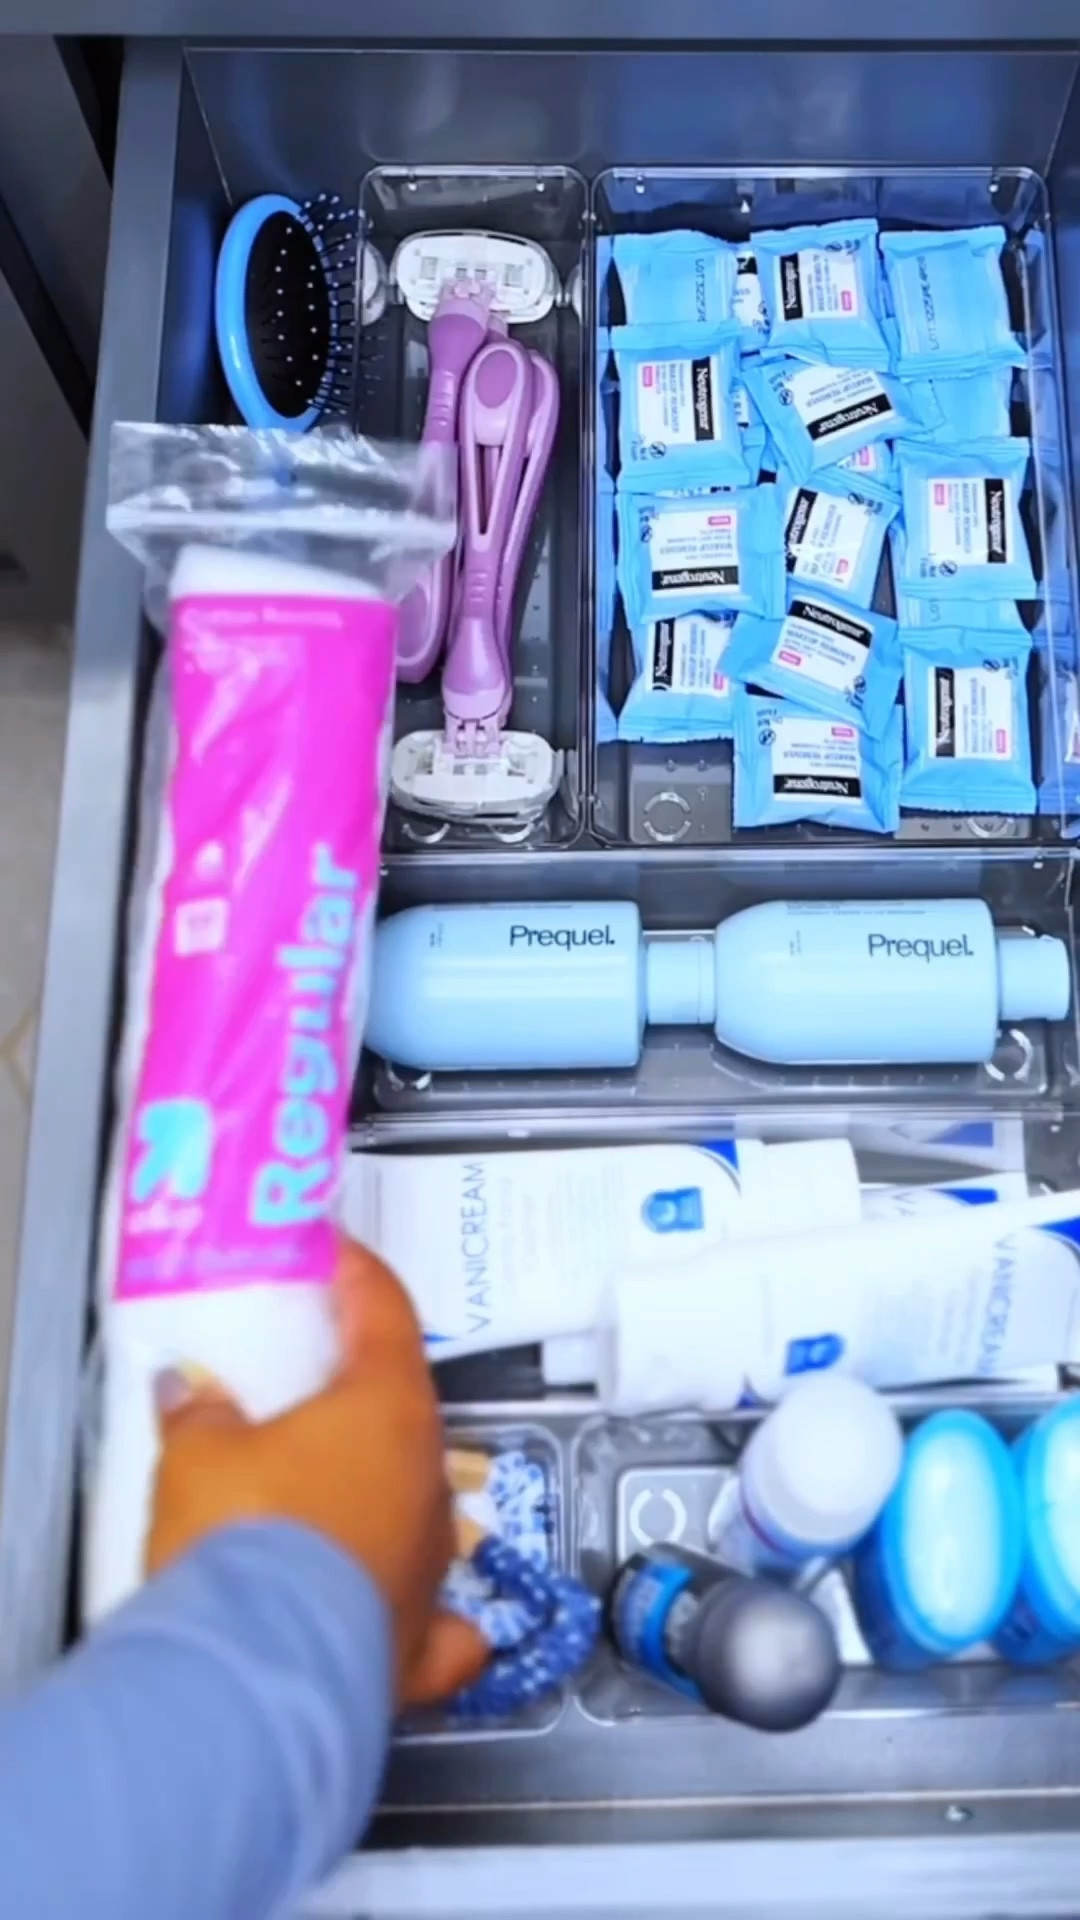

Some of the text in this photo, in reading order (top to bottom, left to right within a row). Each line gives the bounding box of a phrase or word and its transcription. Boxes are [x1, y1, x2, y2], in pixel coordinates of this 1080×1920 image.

[695, 367, 709, 430] Neutrogena
[817, 402, 879, 432] Neutrogena
[989, 490, 1004, 553] Neutrogena
[661, 569, 724, 585] Neutrogena
[803, 605, 865, 639] Neutrogena
[782, 776, 848, 794] Neutrogena
[509, 923, 616, 952] Prequel.
[867, 933, 974, 964] Prequel.
[247, 842, 361, 1227] Regular
[460, 1161, 491, 1335] VANICREAM
